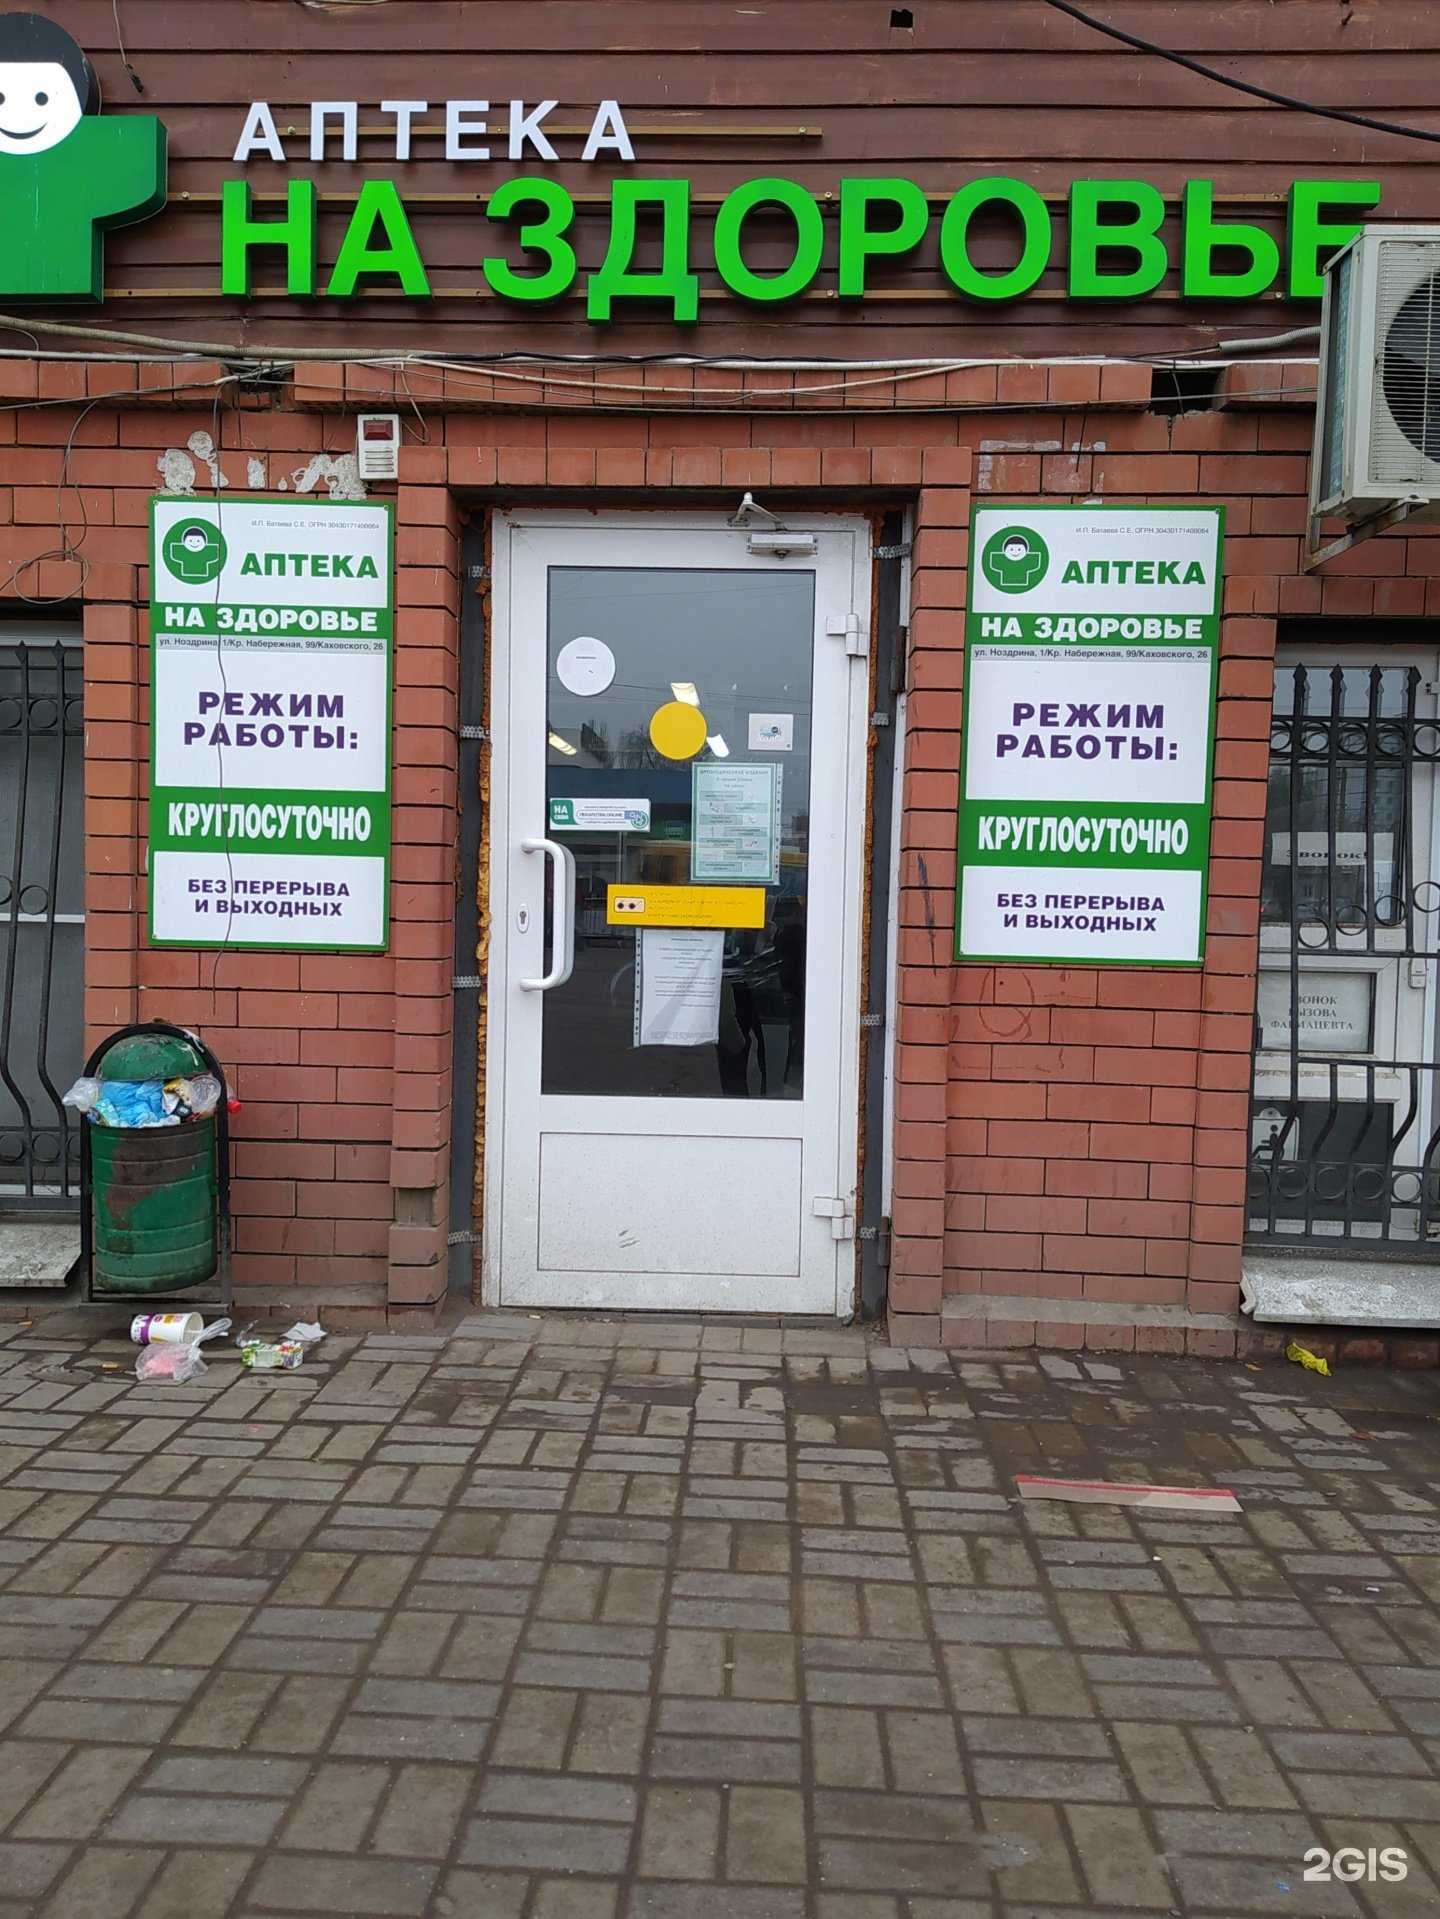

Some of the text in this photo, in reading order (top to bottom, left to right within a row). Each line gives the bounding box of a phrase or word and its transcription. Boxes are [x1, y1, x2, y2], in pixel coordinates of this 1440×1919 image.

[233, 100, 636, 162] АПТЕКА
[222, 177, 1381, 323] НА ЗДОРОВЬЕ
[240, 552, 379, 578] АПТЕКА
[1061, 560, 1207, 585] АПТЕКА
[165, 606, 378, 633] НА ЗДОРОВЬЕ
[981, 617, 1203, 642] НА ЗДОРОВЬЕ
[159, 639, 170, 647] ул.
[246, 640, 302, 649] Набережная,
[373, 642, 383, 650] 26
[974, 649, 987, 658] ул.
[1064, 649, 1124, 659] Набережная,
[1197, 650, 1208, 659] 26
[199, 692, 343, 718] РЕЖИМ
[1013, 702, 1164, 728] РЕЖИМ
[184, 722, 357, 749] РАБОТЫ:
[996, 734, 1177, 760] РАБОТЫ:
[168, 802, 371, 842] КРУГЛОСУТОЧНО
[978, 816, 1189, 855] КРУГЛОСУТОЧНО
[188, 879, 350, 897] БЕЗ ПЕРЕРЫВА
[195, 899, 343, 918] И ВЫХОДНЫХ
[997, 893, 1165, 911] БЕЗ ПЕРЕРЫВА
[1003, 914, 1157, 933] И ВЫХОДНЫХ
